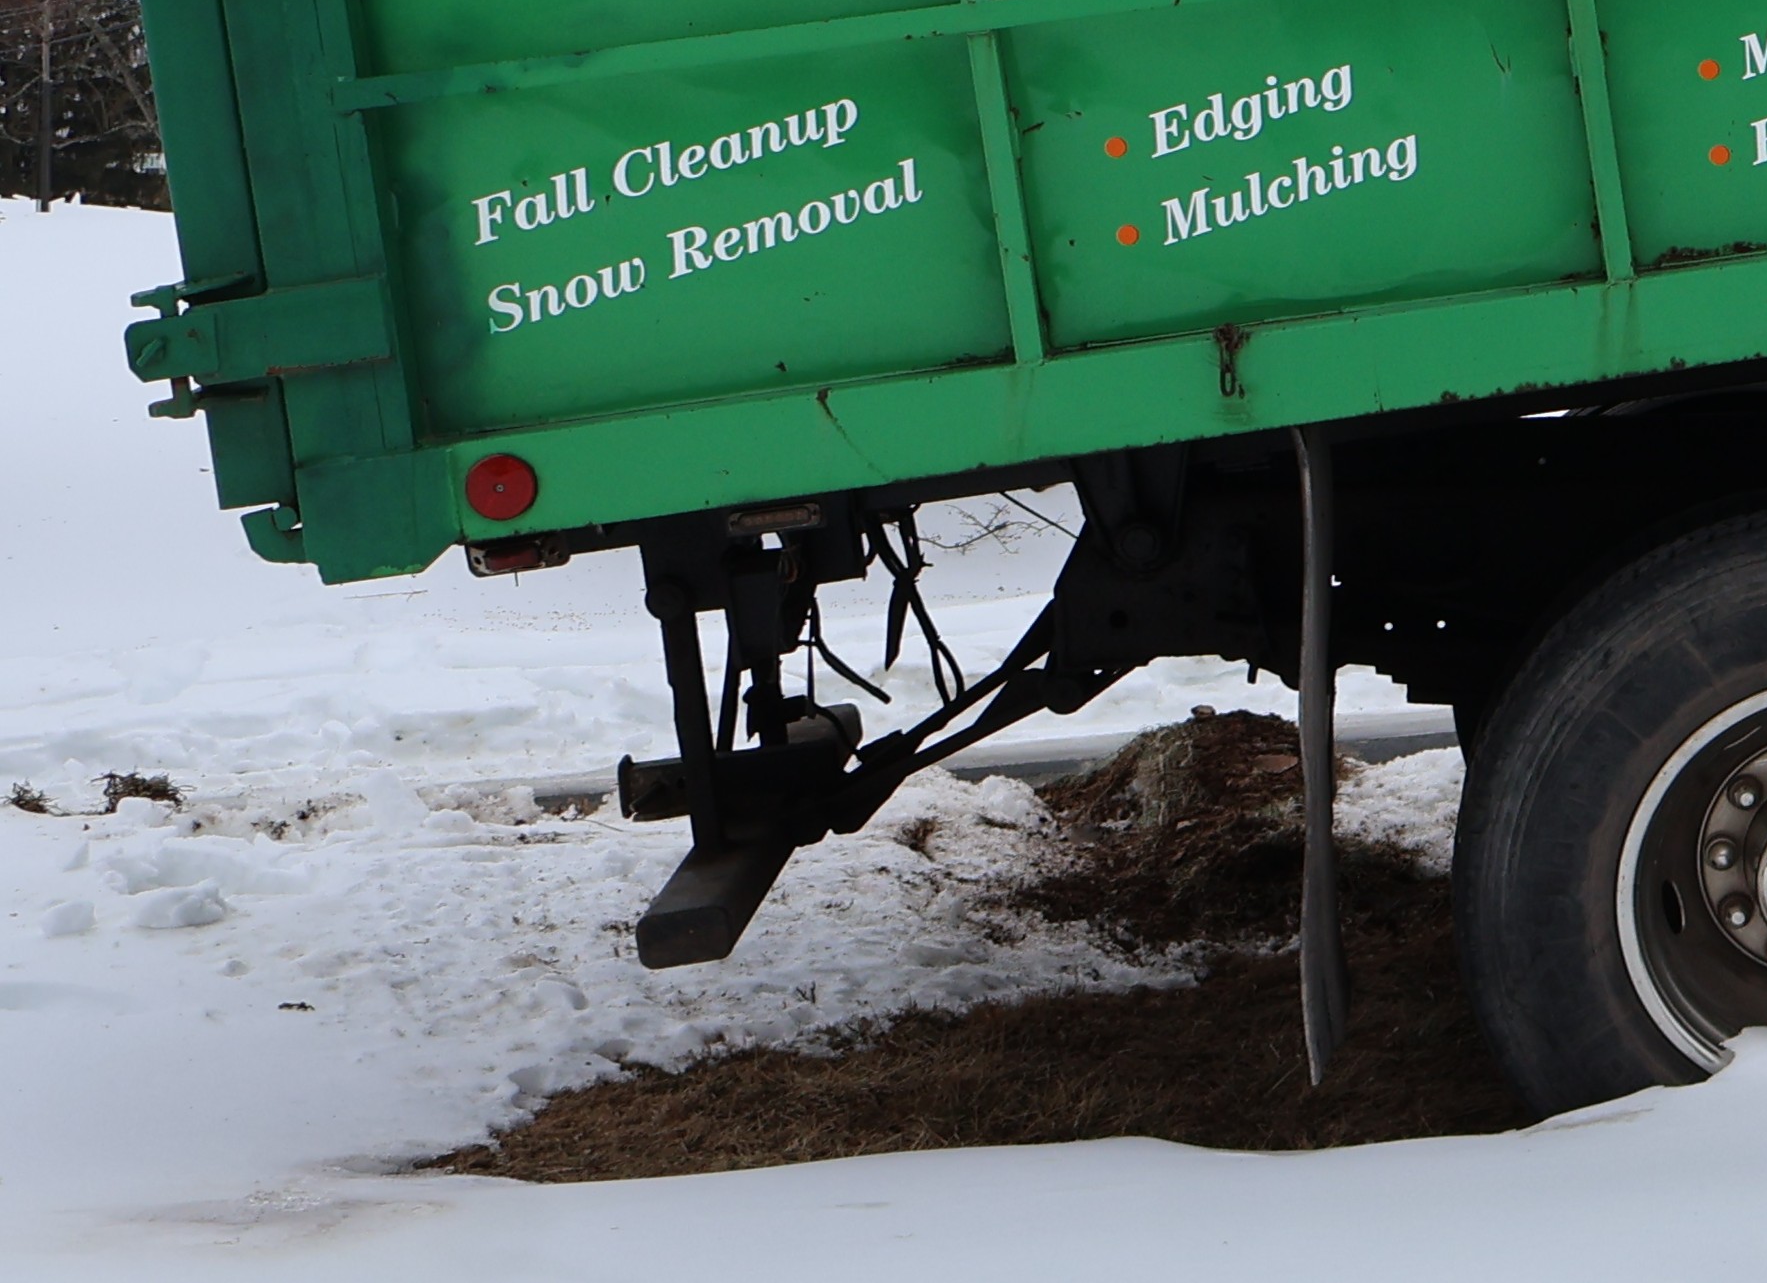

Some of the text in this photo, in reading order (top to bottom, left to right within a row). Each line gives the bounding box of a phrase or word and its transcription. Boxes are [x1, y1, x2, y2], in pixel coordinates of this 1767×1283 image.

[471, 98, 858, 246] Fall Cleanup
[1148, 61, 1354, 158] Edging
[487, 158, 923, 334] Snow Removal
[1161, 131, 1419, 246] Mulching
